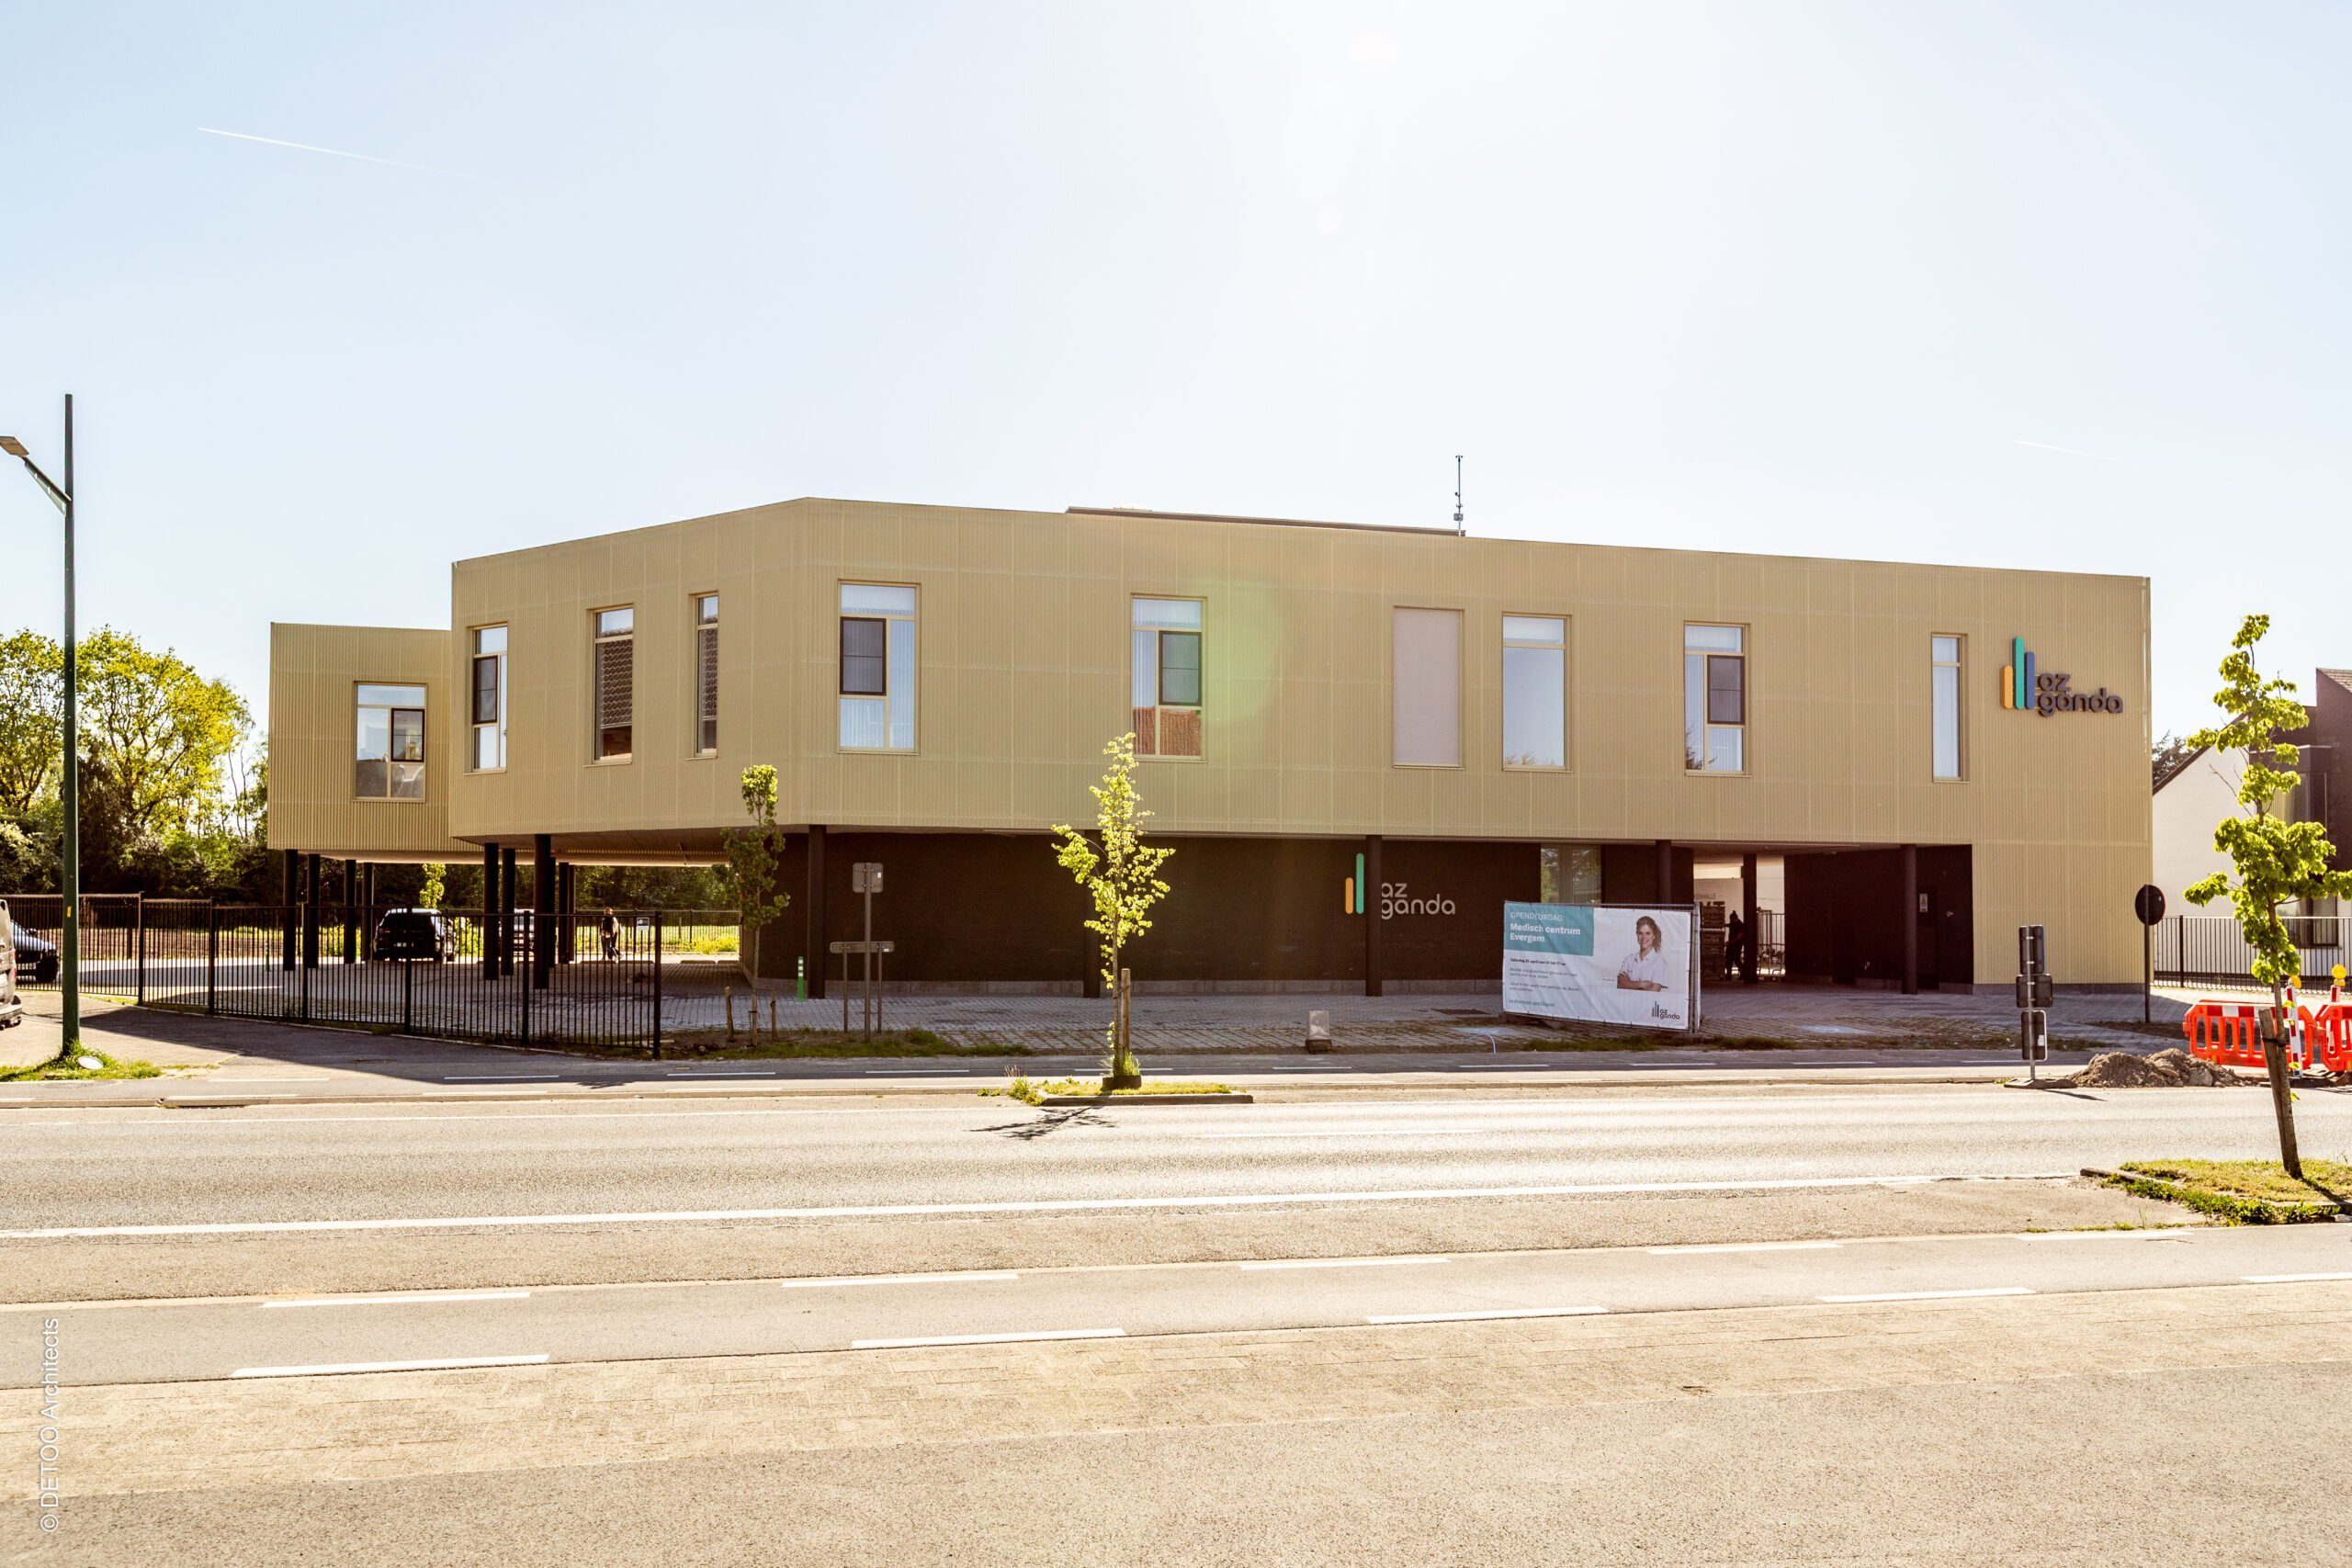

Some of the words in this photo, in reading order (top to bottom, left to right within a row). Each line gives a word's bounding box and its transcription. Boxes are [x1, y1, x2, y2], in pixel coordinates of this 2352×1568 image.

[2038, 672, 2072, 692] az
[2038, 687, 2123, 717] ganda
[1381, 882, 1408, 898] az
[1381, 894, 1456, 920] ganda
[1510, 911, 1563, 921] OPENDEURDAG
[1510, 923, 1544, 932] Medisch
[1544, 926, 1581, 935] centrum
[1510, 932, 1545, 943] Evergem
